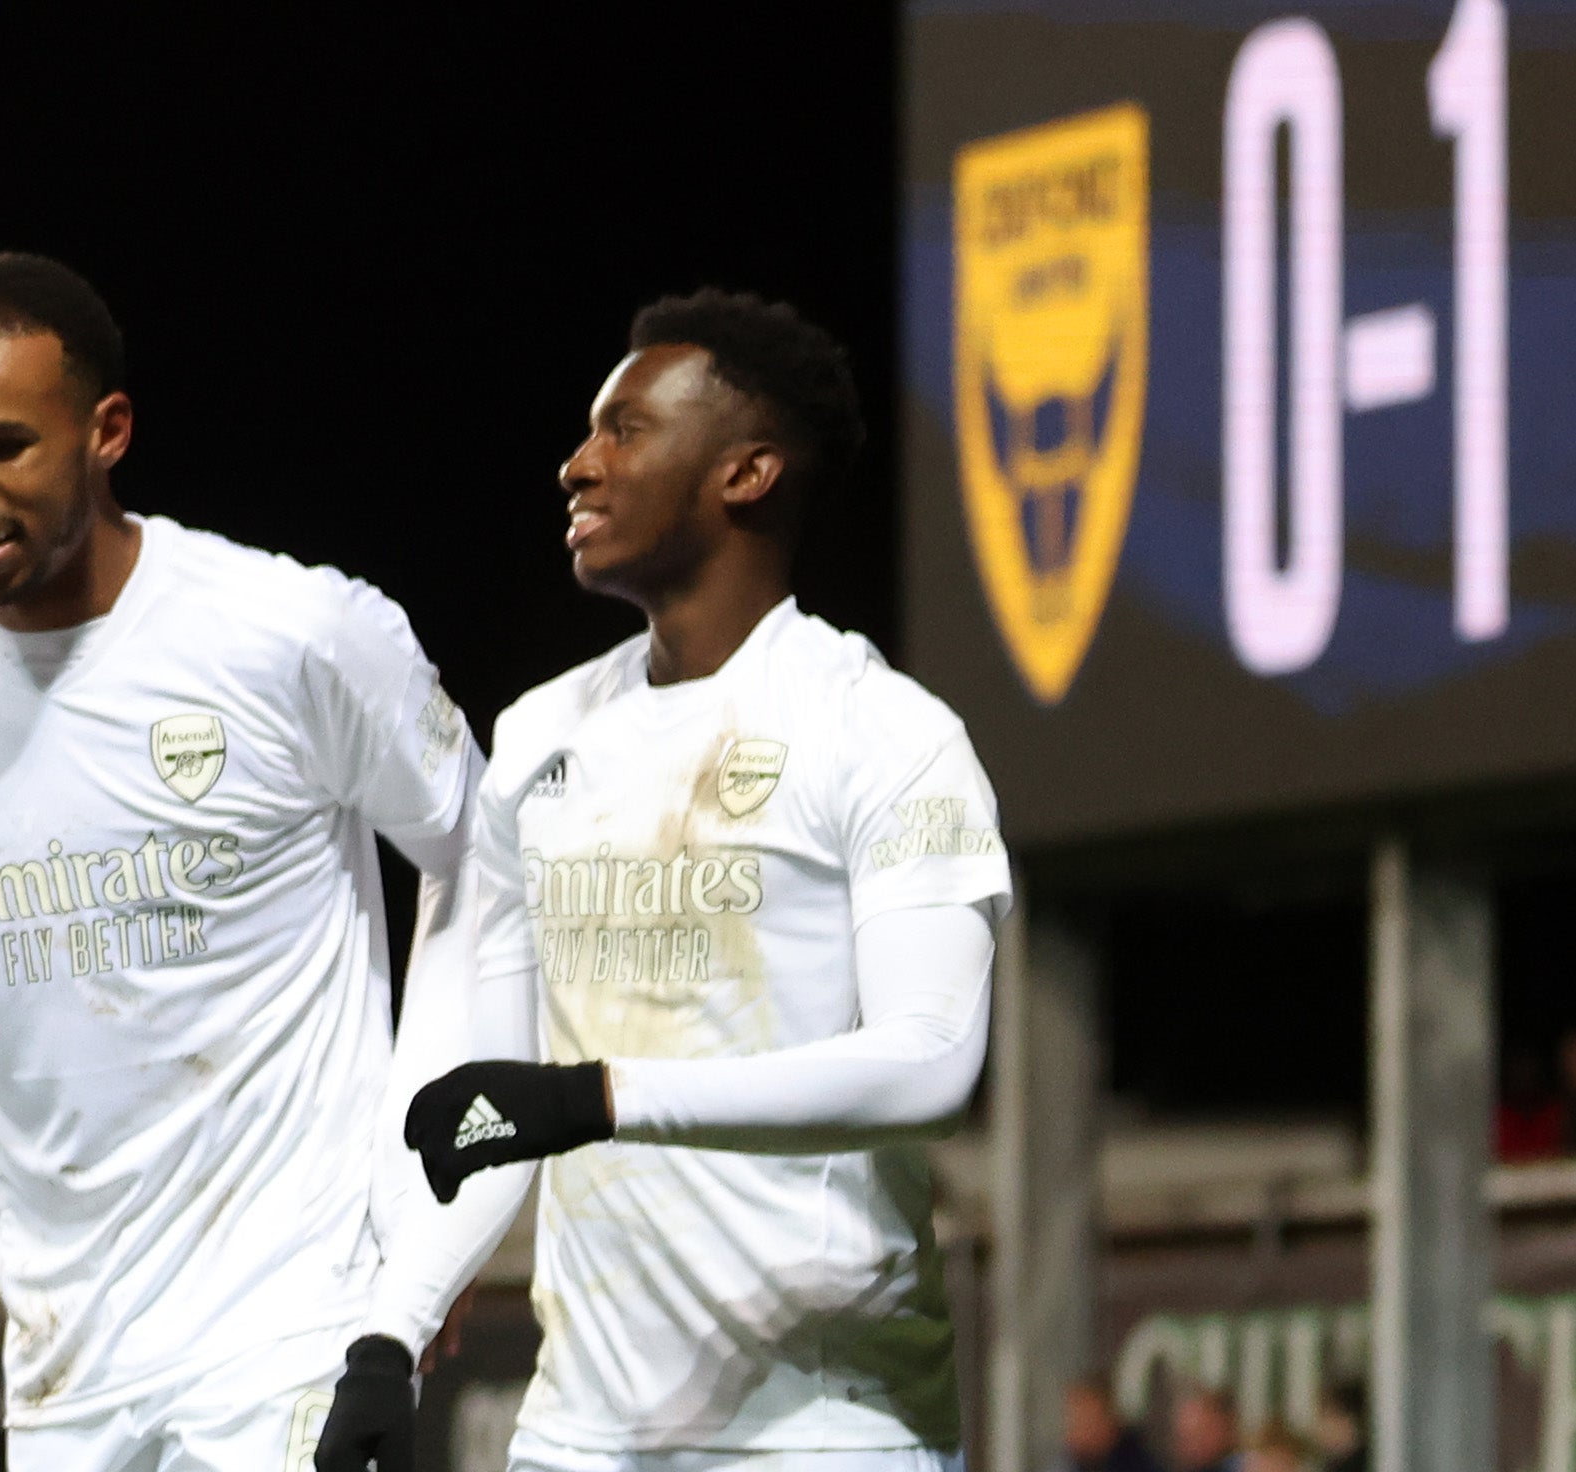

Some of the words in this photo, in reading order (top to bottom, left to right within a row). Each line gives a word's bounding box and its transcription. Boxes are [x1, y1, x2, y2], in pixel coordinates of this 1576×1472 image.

[159, 726, 217, 746] Arsenal
[731, 749, 781, 767] Arsenal
[891, 796, 969, 828] VISIT
[868, 827, 1007, 871] RWANDA
[524, 841, 764, 918] Emirates
[0, 924, 54, 988] FLY
[69, 904, 209, 979] BETTER
[541, 926, 584, 985] FLY
[589, 925, 712, 984] BETTER
[454, 1119, 518, 1150] adidas
